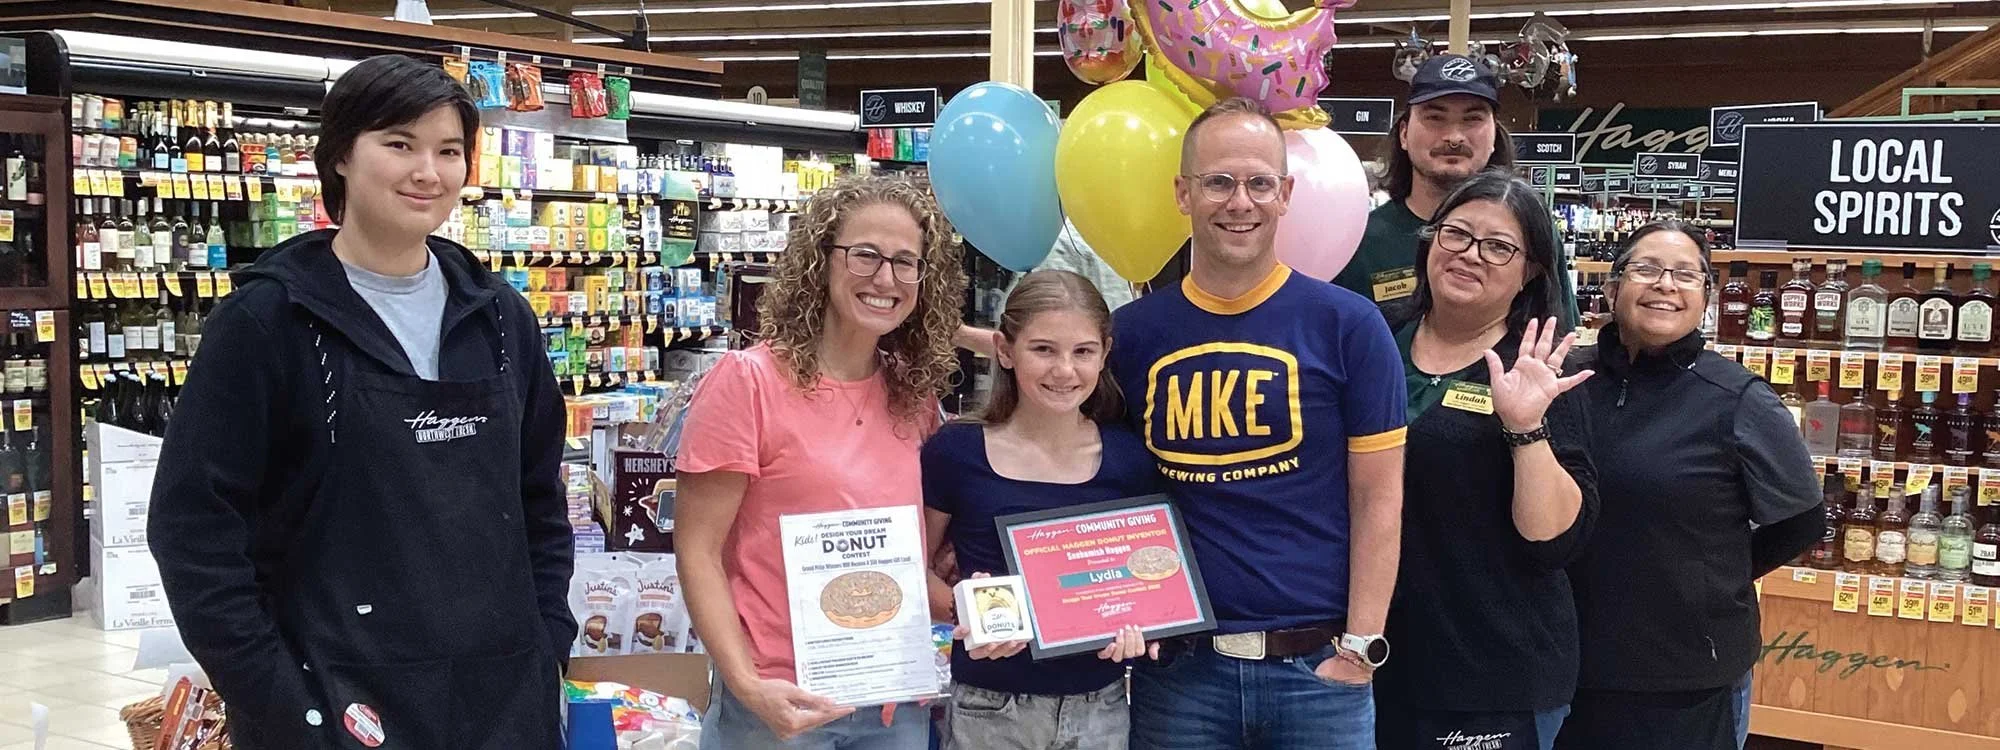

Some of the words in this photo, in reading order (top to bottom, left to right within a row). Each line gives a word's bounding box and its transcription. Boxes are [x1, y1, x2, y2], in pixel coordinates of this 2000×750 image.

[894, 101, 926, 114] WHISKEY
[1355, 110, 1370, 122] GIN
[1569, 102, 1710, 163] Hagg
[1536, 143, 1562, 153] SCOTCH
[1667, 161, 1687, 170] SYRAH
[1829, 139, 1953, 184] LOCAL
[1718, 168, 1738, 177] MERLO
[1813, 190, 1964, 237] SPIRITS
[1384, 281, 1407, 293] Jacob
[1166, 369, 1273, 441] MKE
[1455, 393, 1487, 405] Lindah
[403, 409, 488, 437] Haggen
[624, 457, 676, 473] HERSHEY'S
[1222, 456, 1300, 482] COMPANY
[842, 518, 873, 528] COMMUNITY
[873, 516, 892, 525] GIVING
[1026, 527, 1074, 541] Haggen
[1075, 518, 1127, 535] COMMUNITY
[1127, 513, 1157, 527] GIVING
[112, 535, 124, 545] La
[123, 534, 147, 544] Vieill
[820, 531, 845, 539] DESIGN
[845, 529, 863, 537] YOUR
[863, 527, 887, 535] DREAM
[822, 535, 888, 554] DONUT
[1023, 544, 1061, 557] OFFICIAL
[1062, 538, 1096, 550] HAGGEN
[1097, 534, 1126, 546] DONUT
[1127, 529, 1167, 541] INVENTOR
[1105, 544, 1132, 557] Haggen
[841, 551, 871, 560] CONTEST
[1089, 568, 1123, 585] Lydia
[585, 581, 618, 596] Justin's
[637, 579, 675, 594] Justin's
[112, 619, 124, 628] La
[124, 617, 150, 628] Vieille
[1762, 631, 1950, 680] Haggen
[1436, 730, 1511, 746] Haggen
